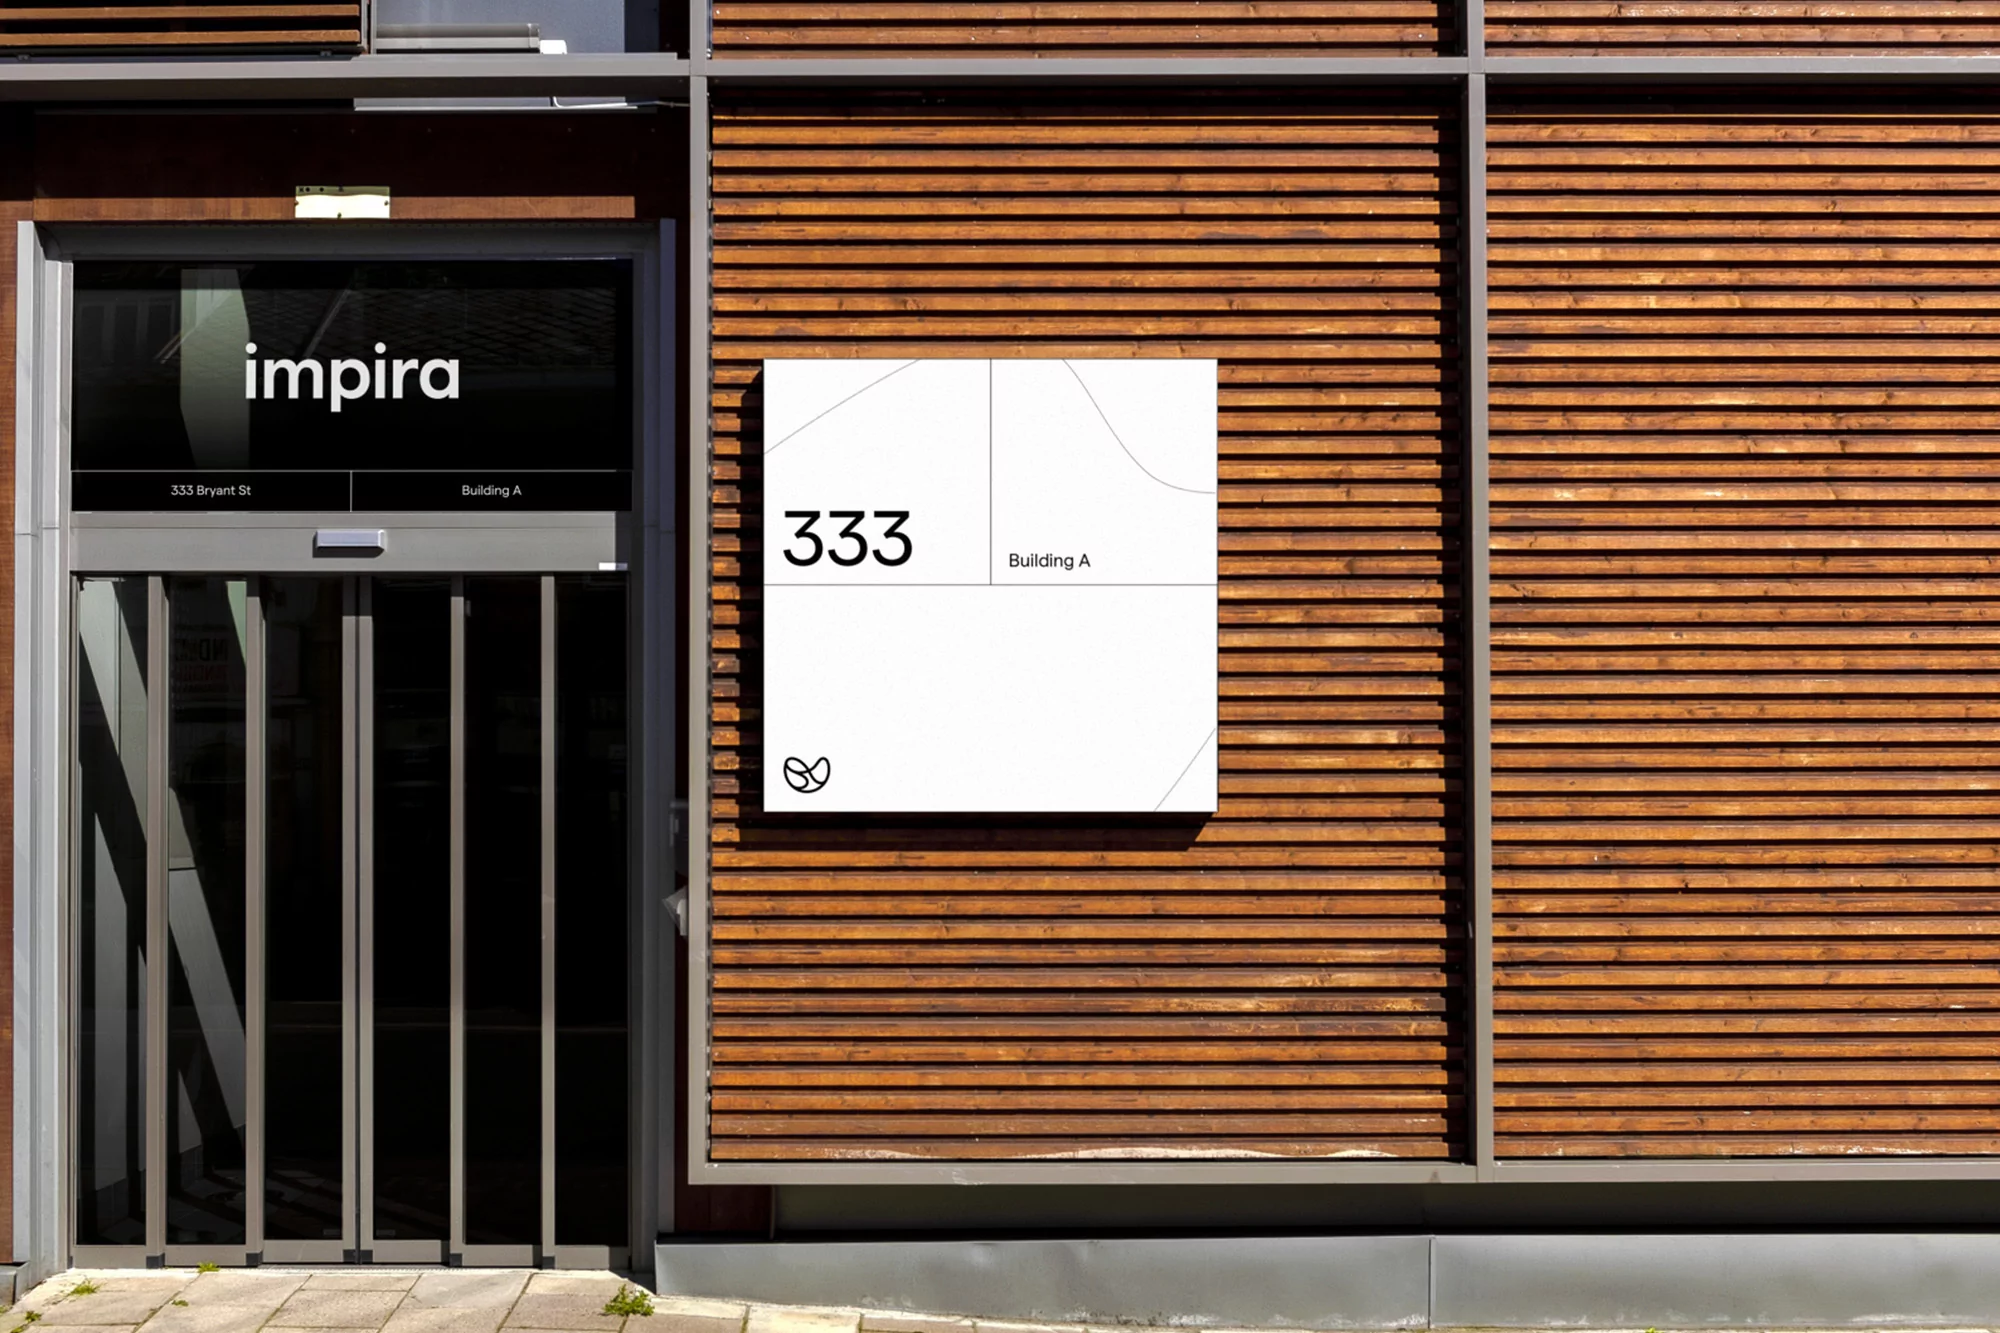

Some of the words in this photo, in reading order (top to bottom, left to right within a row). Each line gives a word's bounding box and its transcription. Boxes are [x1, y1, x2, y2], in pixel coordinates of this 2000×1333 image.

[244, 341, 460, 412] impira
[170, 484, 194, 497] 333
[196, 484, 236, 499] Bryant
[238, 484, 252, 497] St
[461, 484, 510, 499] Building
[512, 484, 523, 497] A
[782, 510, 914, 567] 333
[1008, 552, 1074, 571] Building
[1078, 553, 1092, 568] A
